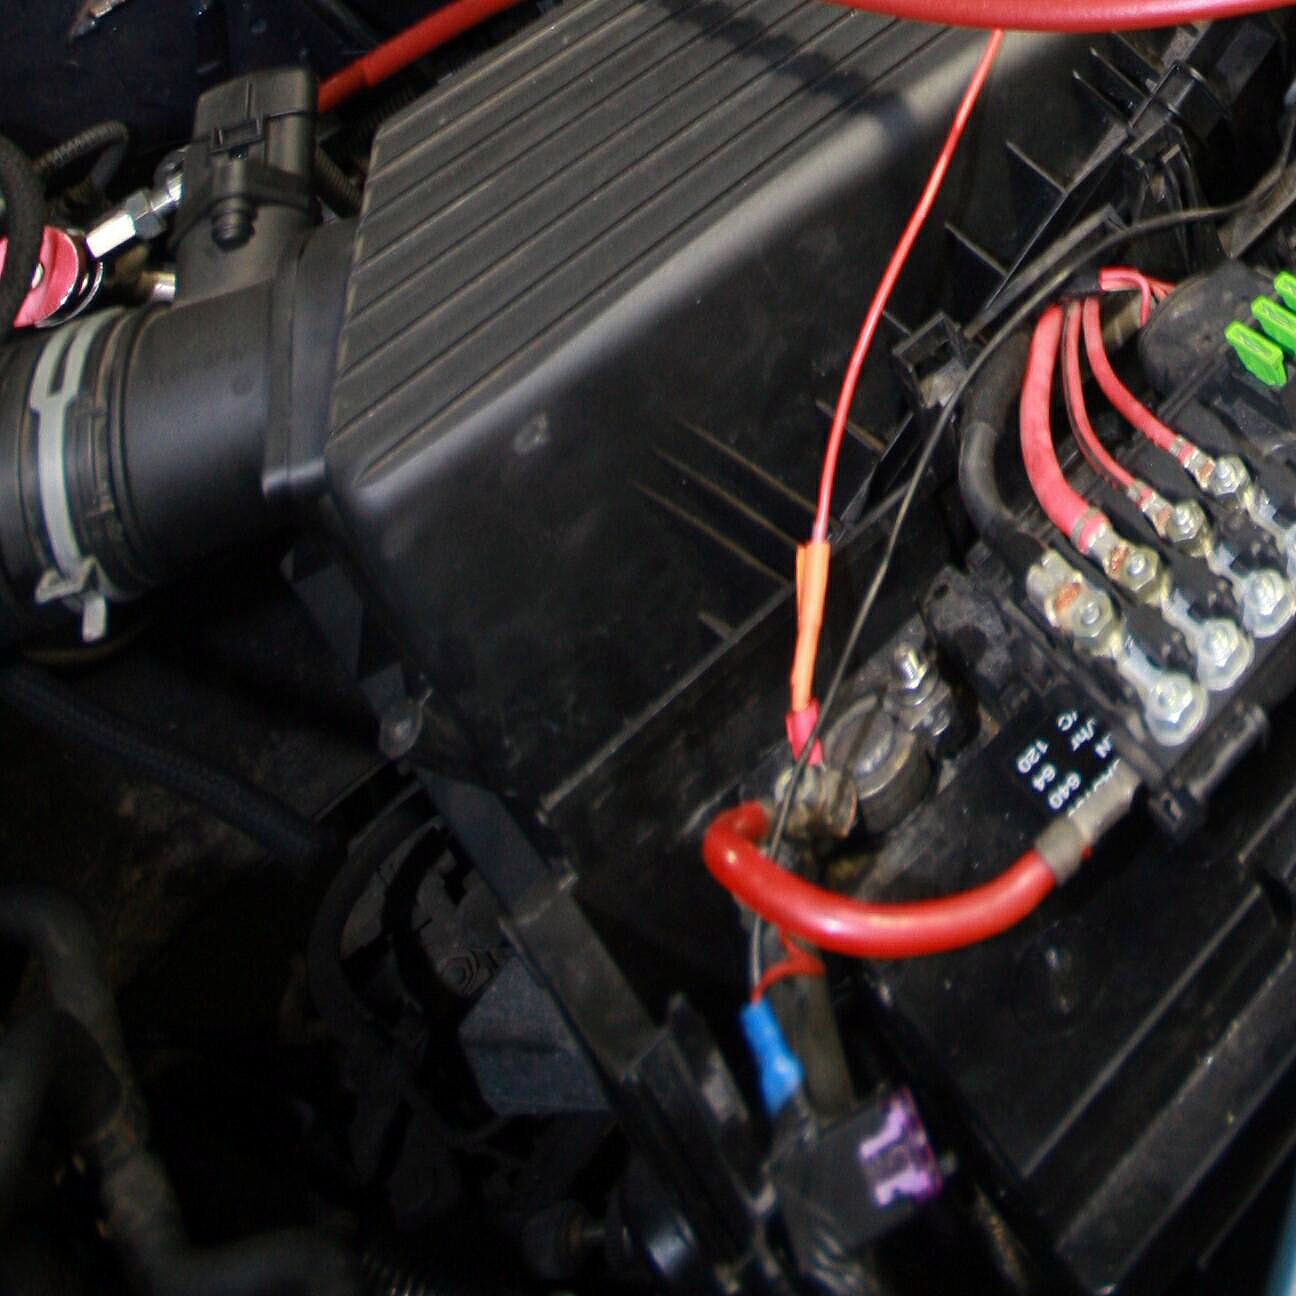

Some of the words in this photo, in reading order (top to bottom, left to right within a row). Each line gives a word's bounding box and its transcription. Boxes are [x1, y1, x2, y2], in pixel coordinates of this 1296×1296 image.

[1018, 739, 1048, 773] 120
[1032, 764, 1055, 792] 64
[1048, 772, 1080, 809] 640
